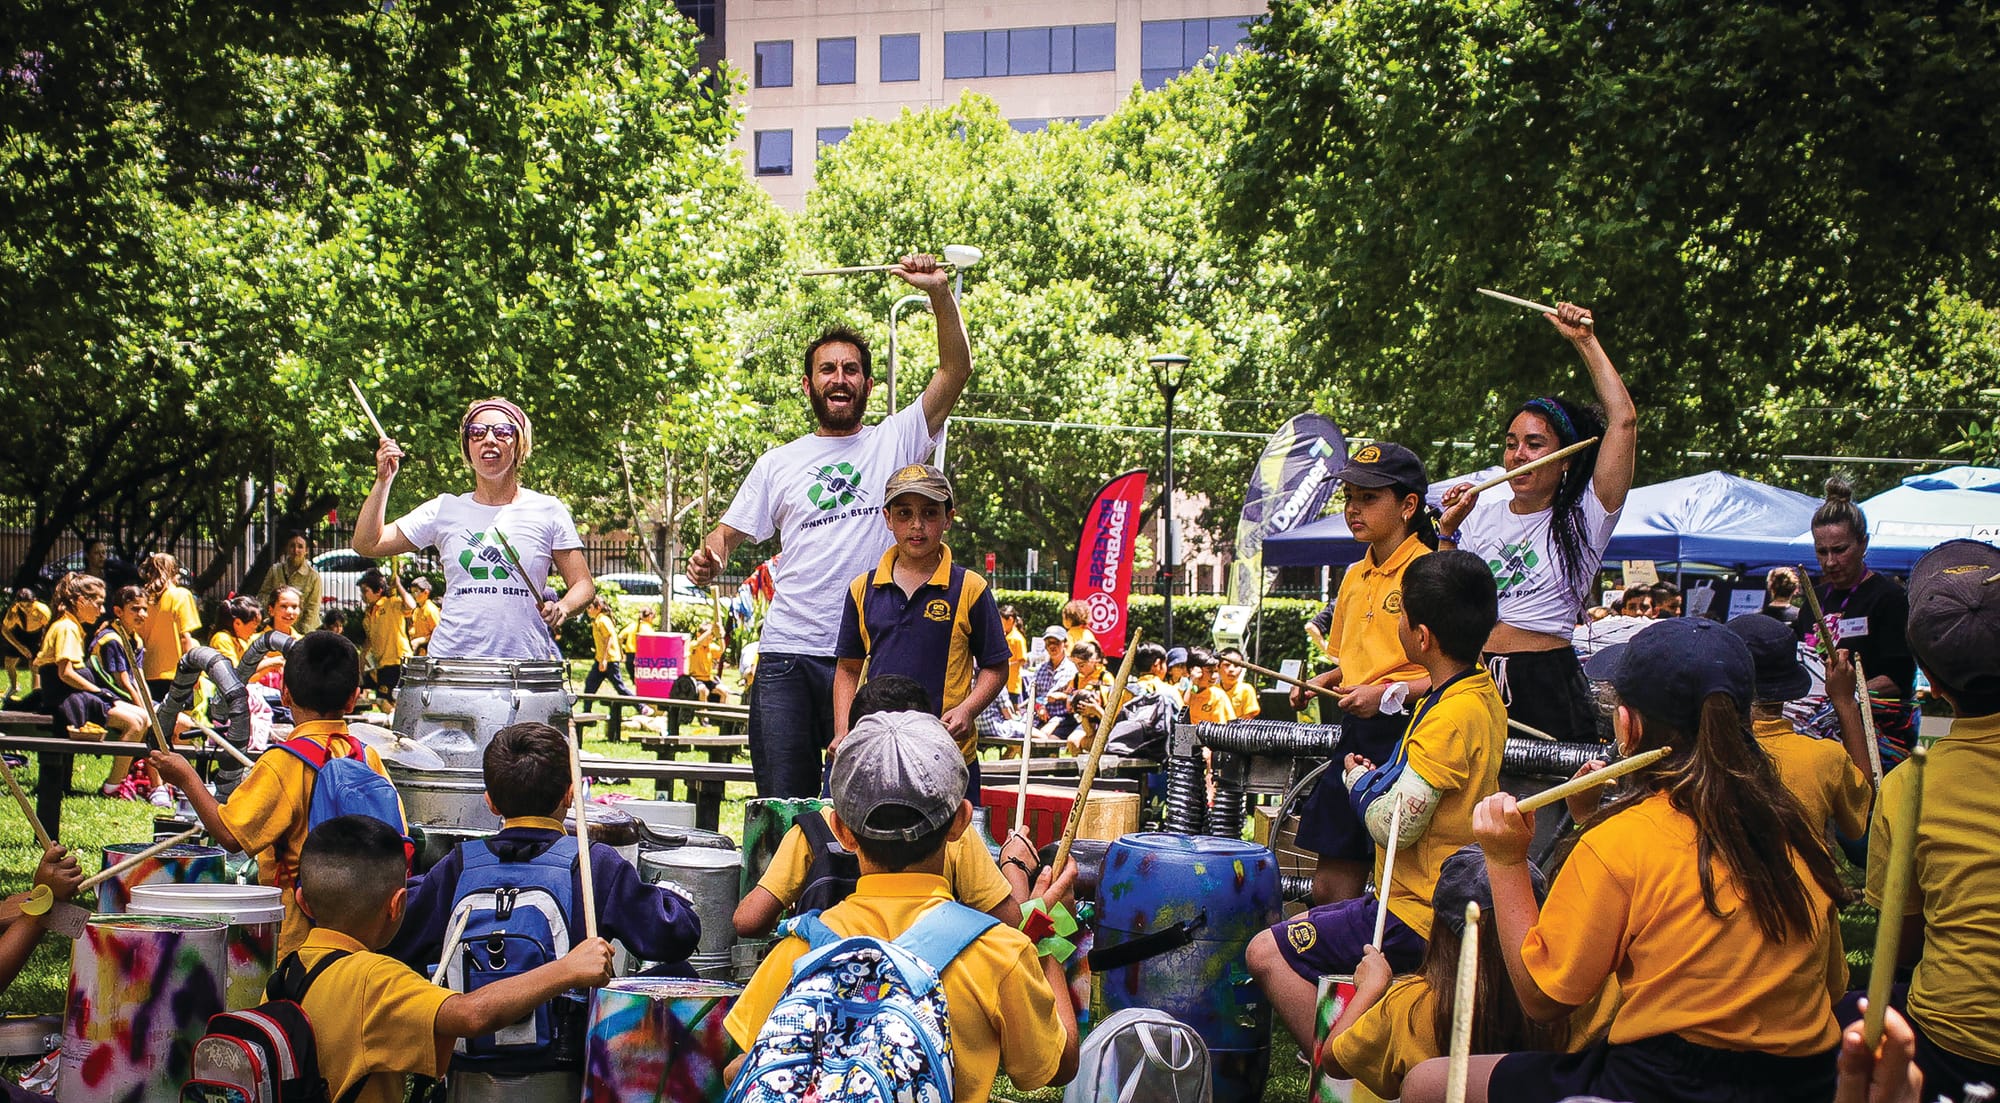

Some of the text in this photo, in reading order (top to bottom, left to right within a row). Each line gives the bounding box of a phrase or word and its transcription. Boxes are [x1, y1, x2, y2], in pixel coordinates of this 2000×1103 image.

[850, 506, 880, 518] BEATS
[1271, 457, 1329, 532] Downer
[1102, 499, 1128, 593] GARBAGE
[502, 586, 529, 597] BEATS
